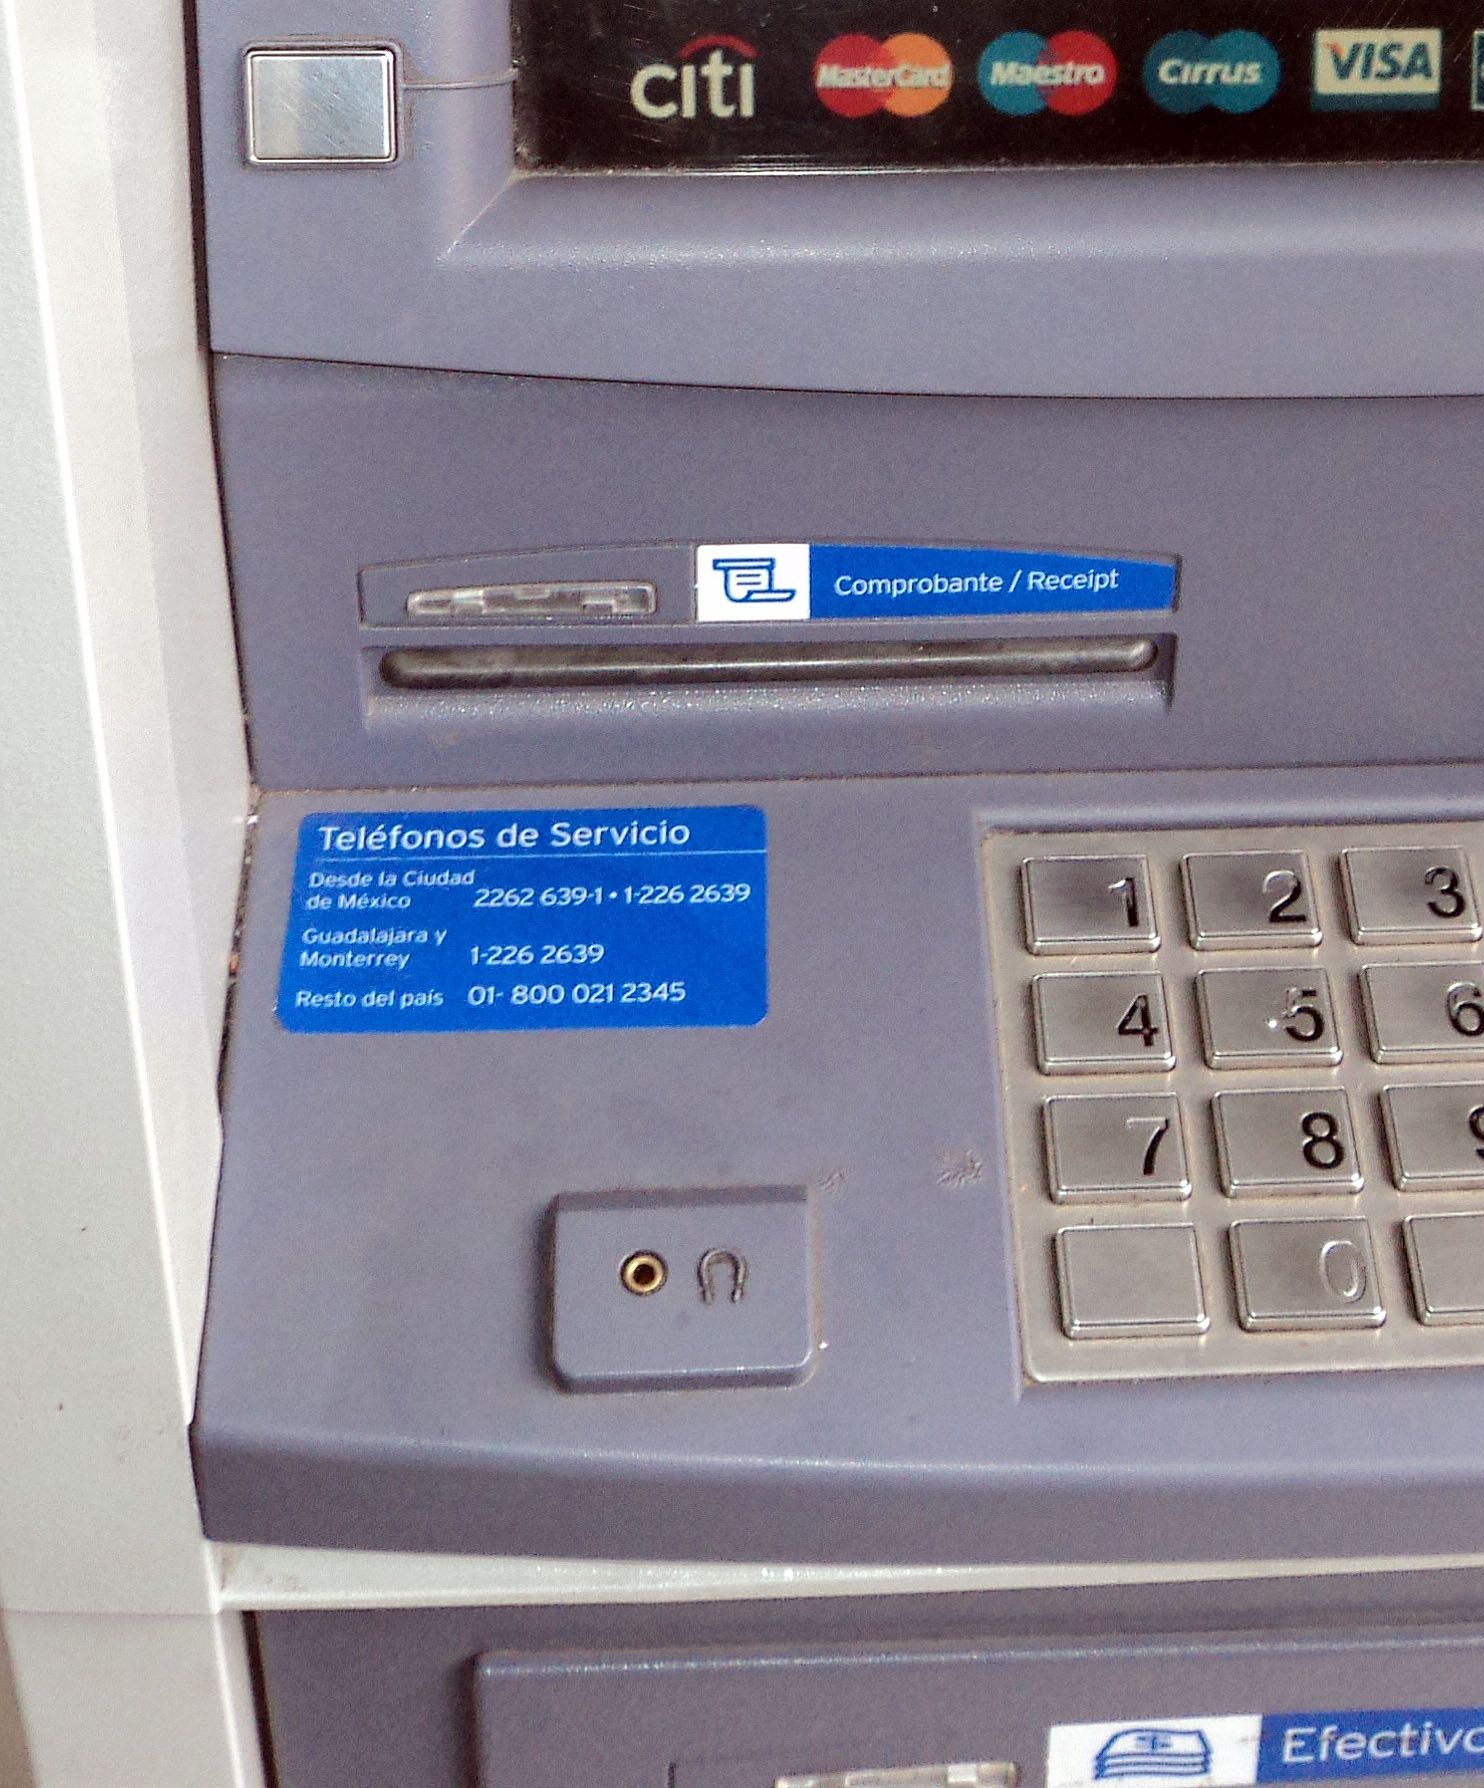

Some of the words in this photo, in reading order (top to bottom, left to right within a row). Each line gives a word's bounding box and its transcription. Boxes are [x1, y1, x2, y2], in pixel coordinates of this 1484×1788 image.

[815, 61, 952, 89] MasterCard
[990, 60, 1106, 87] Maestro
[1157, 58, 1262, 85] Cirrus
[1327, 41, 1433, 82] VISA
[630, 50, 755, 119] citi
[834, 572, 1003, 597] Comprobante
[1010, 570, 1020, 592] /
[1028, 567, 1120, 594] Receipt
[319, 824, 485, 851] Teléfonos
[497, 822, 539, 848] de
[550, 820, 691, 848] Servicio
[309, 872, 373, 888] Desde
[378, 871, 397, 886] la
[403, 869, 476, 886] Ciudad
[1424, 866, 1466, 918] 3
[306, 894, 332, 910] de
[338, 892, 412, 909] México
[474, 887, 535, 908] 2262
[624, 885, 685, 904] 1-226
[689, 883, 751, 904] 2639
[1108, 876, 1139, 928] 1
[1262, 869, 1307, 924] 2
[302, 928, 429, 946] Guadalajara
[434, 929, 447, 946] y
[301, 951, 411, 969] Monterrey
[470, 945, 535, 966] 1-226
[540, 943, 605, 965] 2639
[296, 991, 357, 1008] Resto
[361, 990, 395, 1007] del
[400, 988, 444, 1009] país
[511, 984, 565, 1005] 800
[571, 982, 615, 1004] 021
[620, 981, 687, 1004] 2345
[1117, 994, 1159, 1047] 4
[1285, 986, 1325, 1043] 5
[1126, 1116, 1169, 1175] 7
[1302, 1111, 1345, 1170] 8
